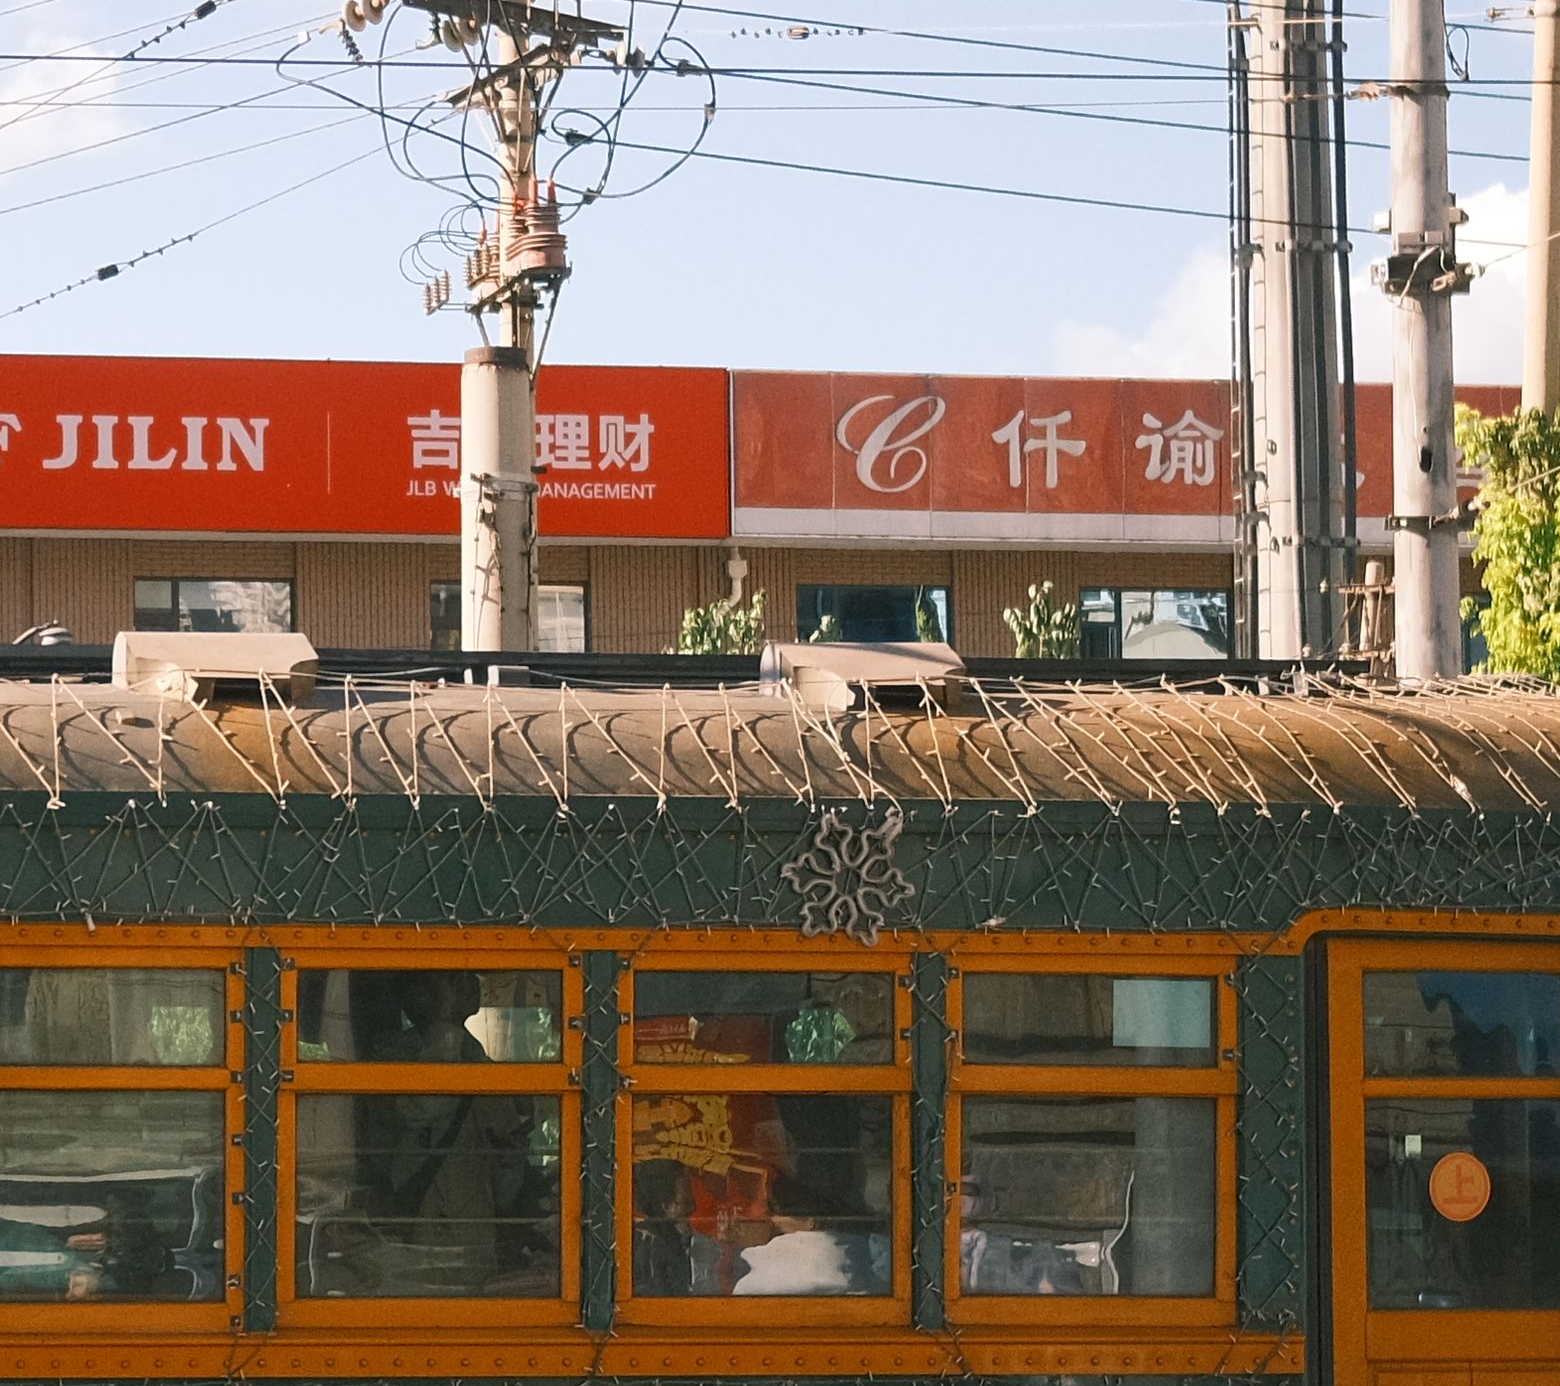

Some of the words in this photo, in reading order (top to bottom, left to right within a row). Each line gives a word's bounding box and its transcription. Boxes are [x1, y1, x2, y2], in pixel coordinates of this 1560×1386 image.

[42, 414, 270, 472] JILIN
[407, 409, 655, 472] 吉理财
[406, 480, 436, 496] JLB
[536, 482, 656, 500] ANAGEMENT
[1441, 1163, 1481, 1205] 上
